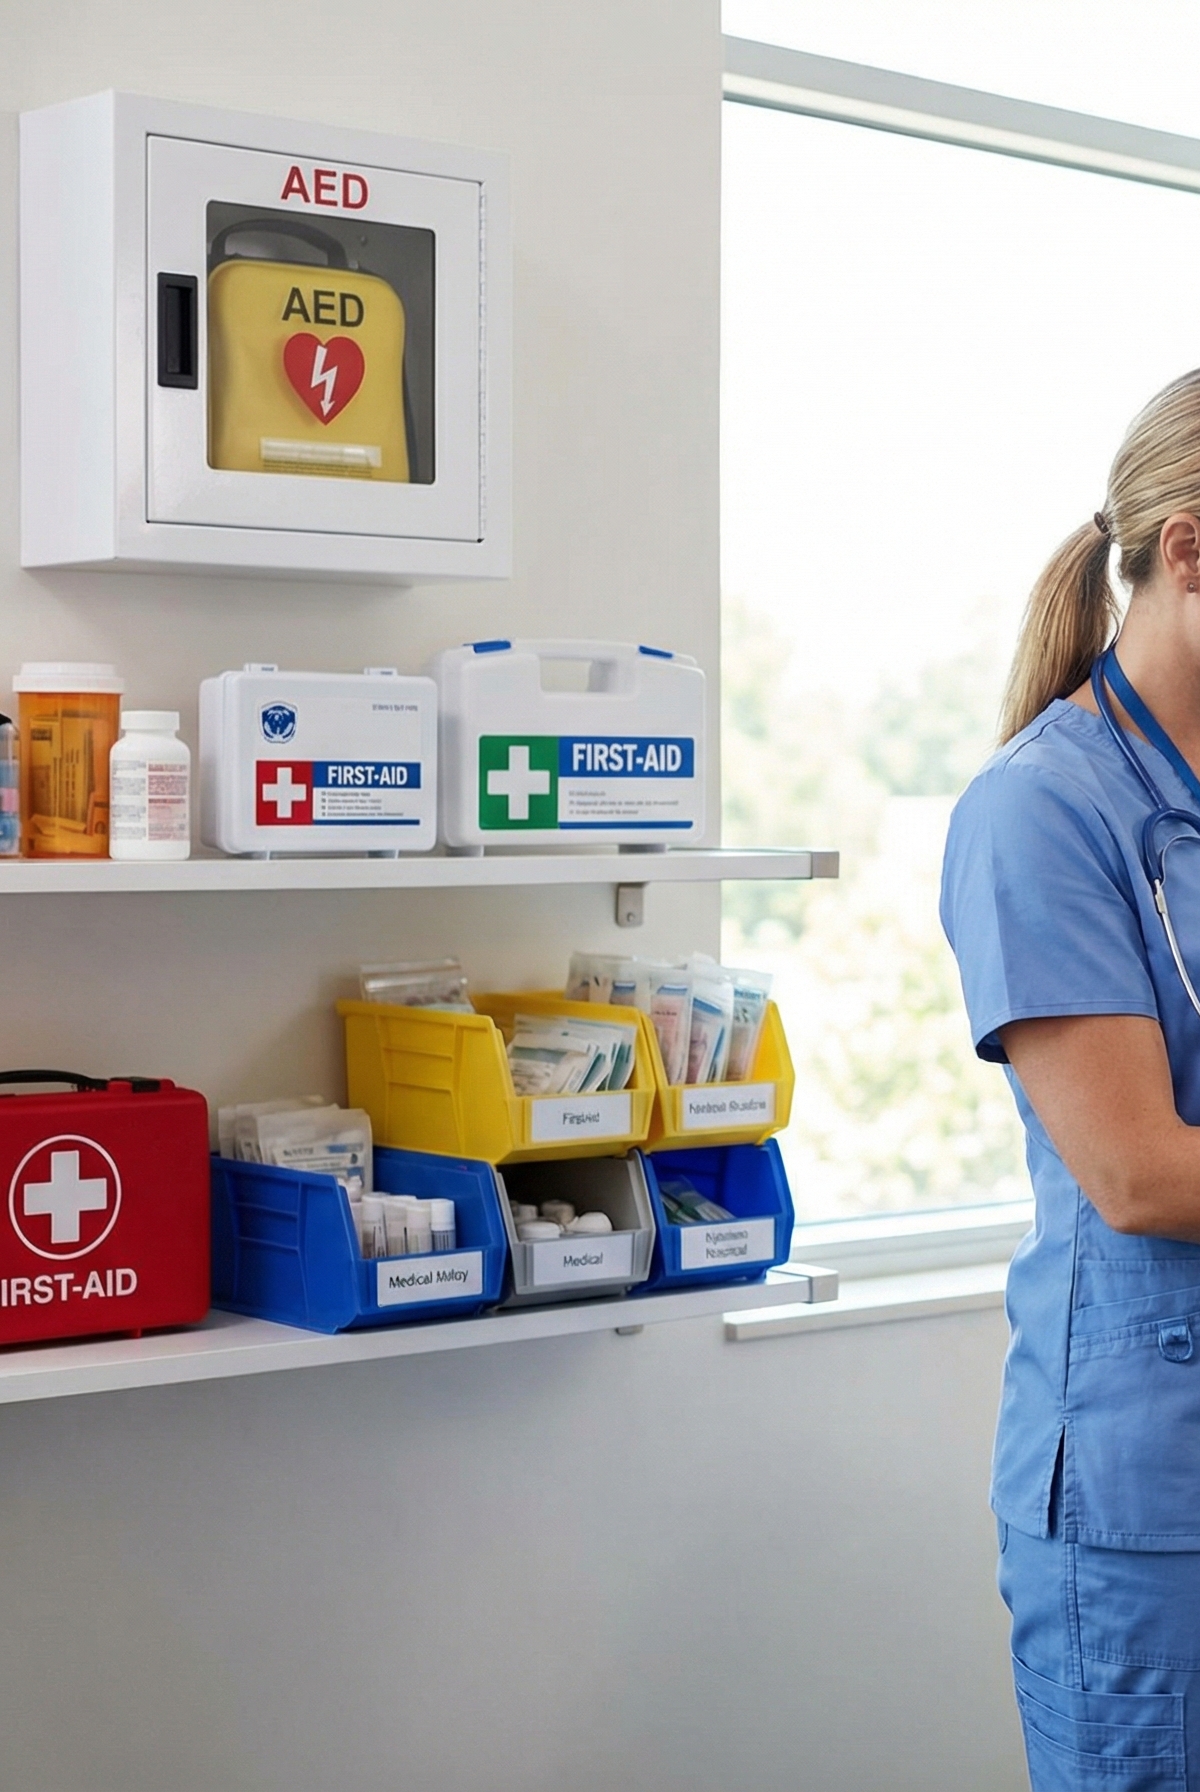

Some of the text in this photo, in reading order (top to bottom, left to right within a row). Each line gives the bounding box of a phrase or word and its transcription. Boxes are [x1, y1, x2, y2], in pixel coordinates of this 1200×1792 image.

[281, 165, 369, 210] AED
[281, 286, 365, 327] AED
[572, 742, 682, 772] FIRST-AID
[0, 1267, 138, 1307] IRST-AID
